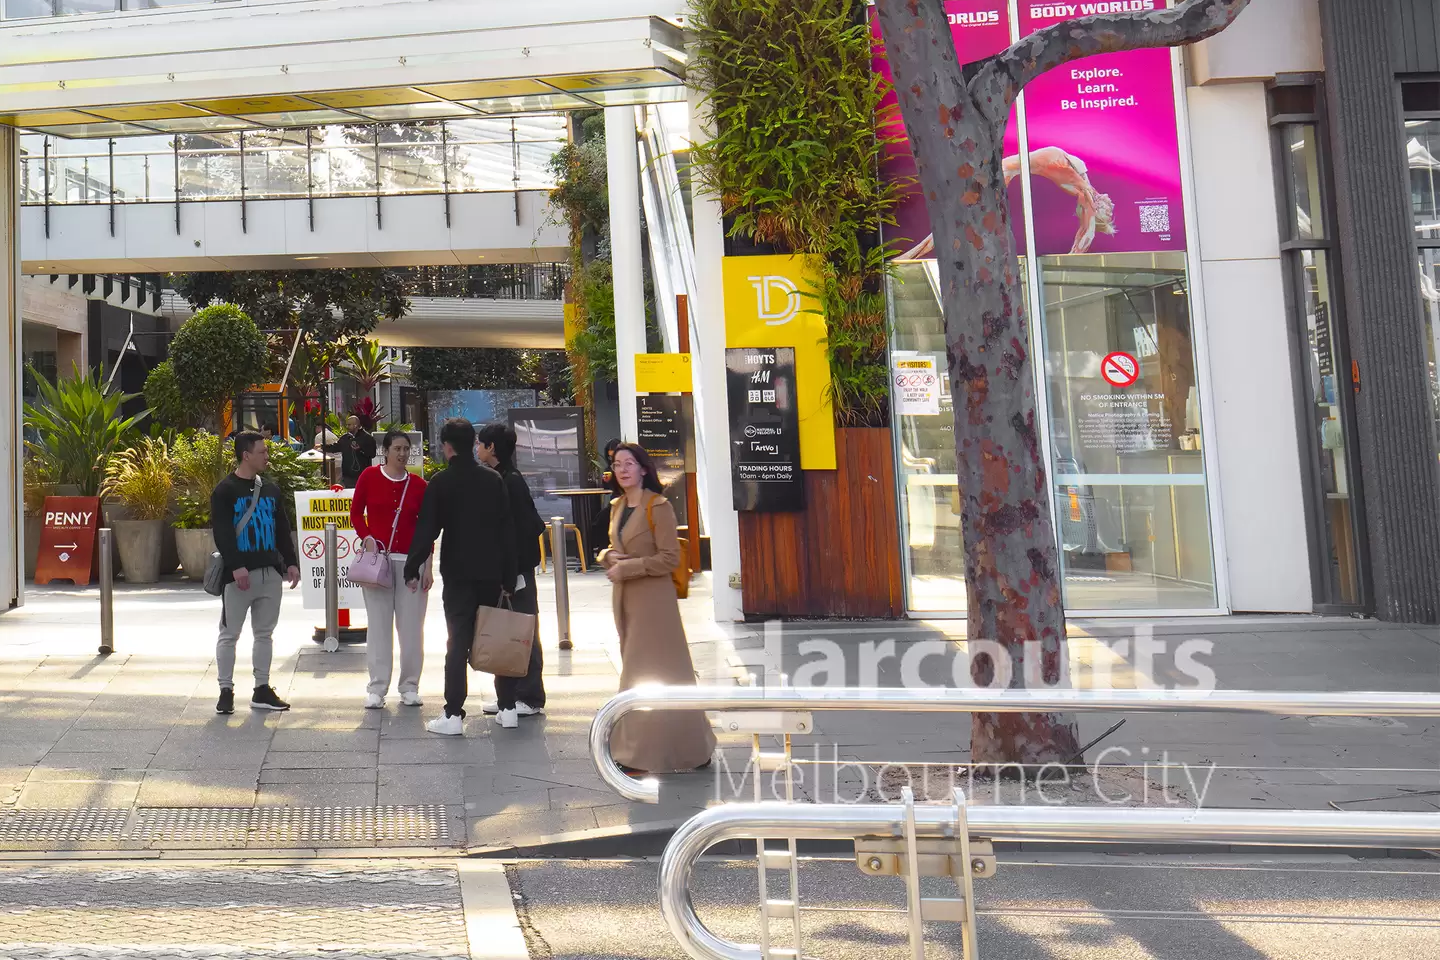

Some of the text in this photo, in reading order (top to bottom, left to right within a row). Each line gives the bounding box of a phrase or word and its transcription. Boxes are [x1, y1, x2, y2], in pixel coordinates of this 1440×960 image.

[1030, 0, 1154, 19] BODY WORLDS
[947, 10, 999, 25] ORLDS
[1070, 67, 1124, 81] Explore.
[1077, 83, 1119, 94] Learn.
[1061, 95, 1139, 110] Be Inspired.
[747, 355, 775, 364] HOYTS
[751, 370, 770, 383] H&M
[312, 500, 327, 512] ALL
[45, 512, 92, 525] PENNY
[303, 516, 354, 529] MUST ISMO
[313, 578, 361, 588] OF VISITO
